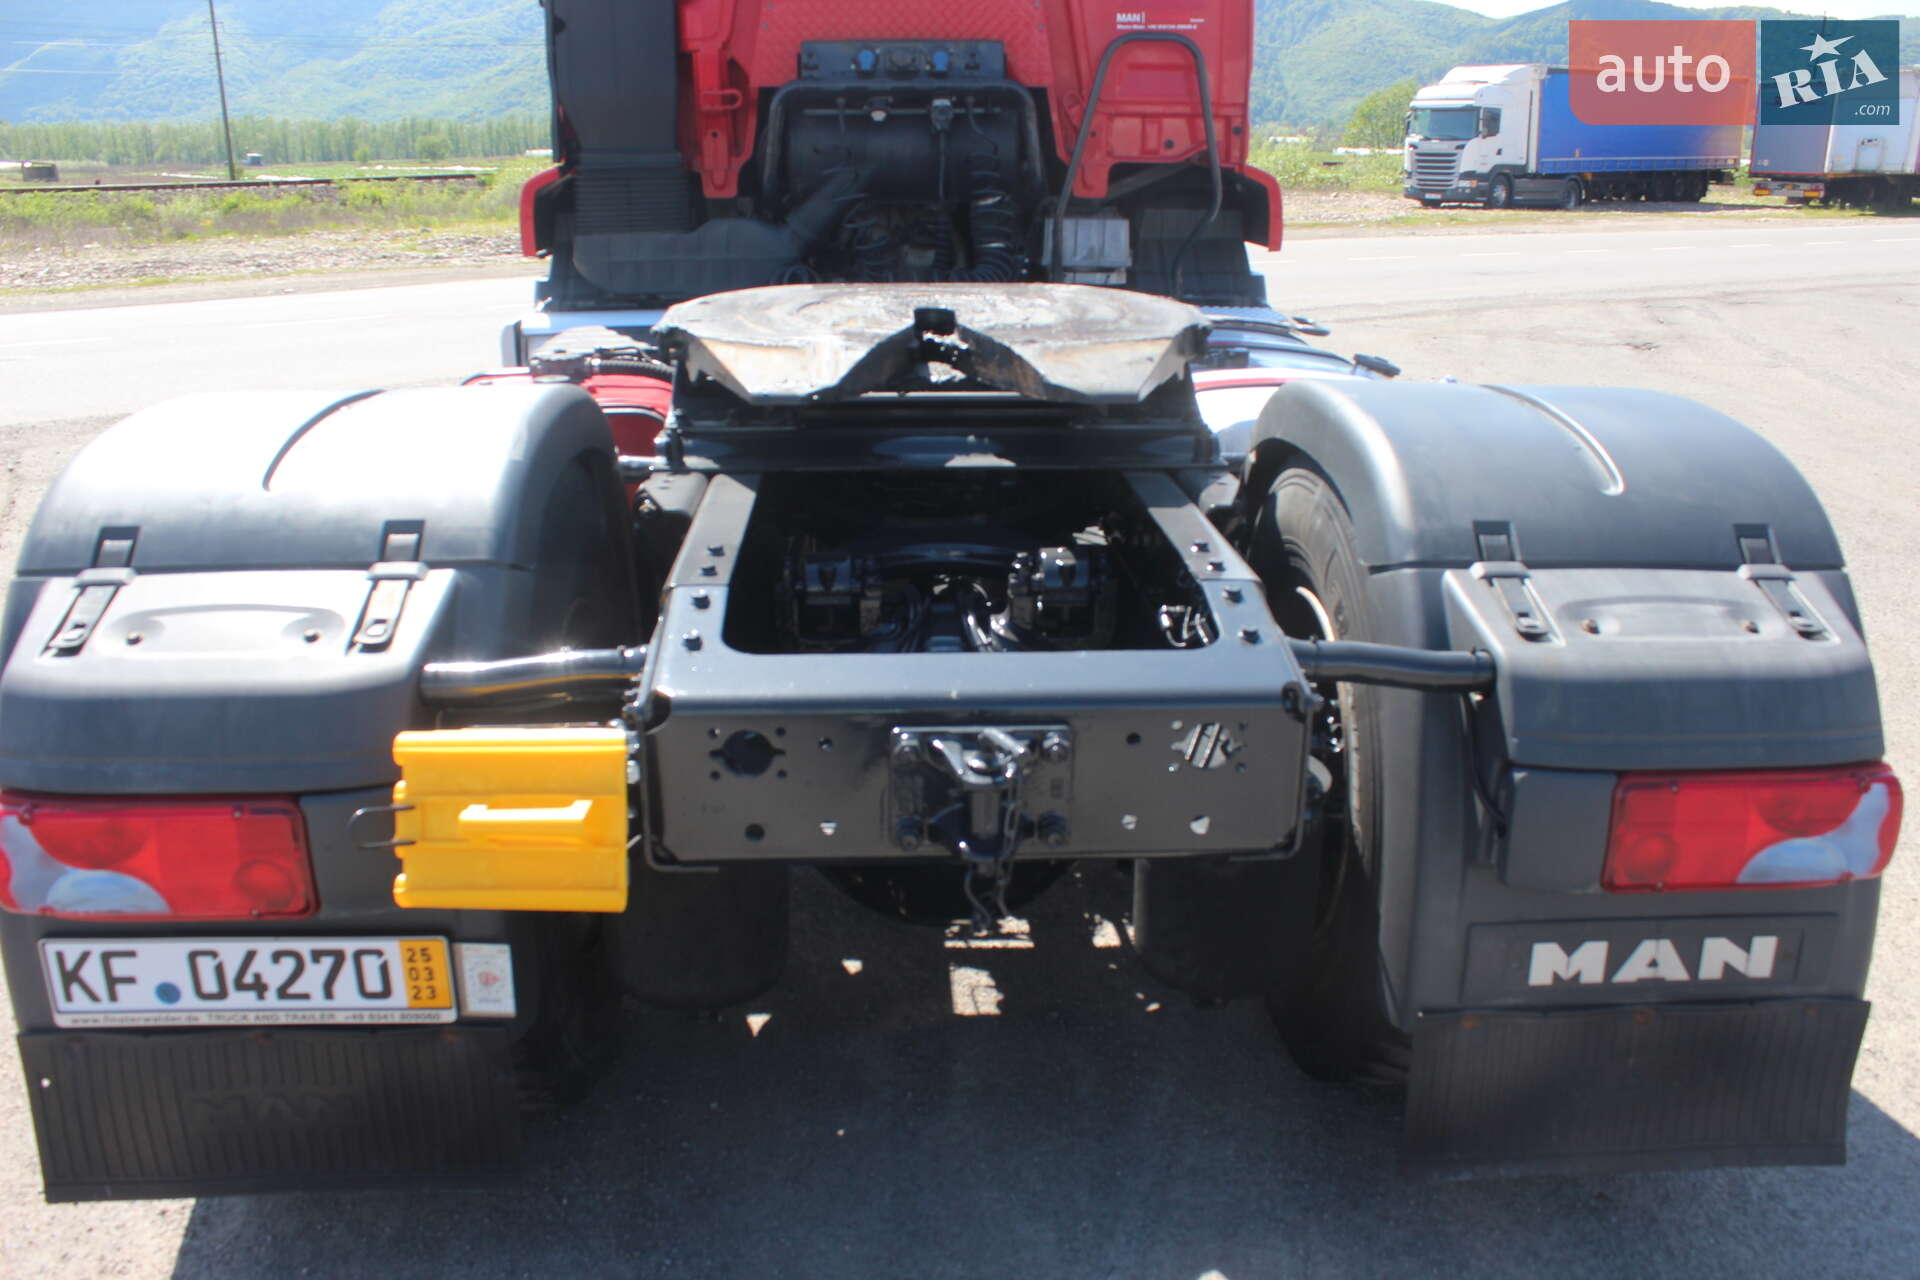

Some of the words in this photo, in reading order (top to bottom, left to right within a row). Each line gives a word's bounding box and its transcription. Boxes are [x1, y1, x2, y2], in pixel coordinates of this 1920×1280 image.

[1116, 12, 1141, 23] MAN
[406, 947, 432, 963] 25
[1528, 935, 1779, 986] MAN
[55, 950, 138, 1003] KF
[187, 949, 393, 1000] 04270
[408, 966, 434, 982] 03
[411, 985, 437, 1000] 23
